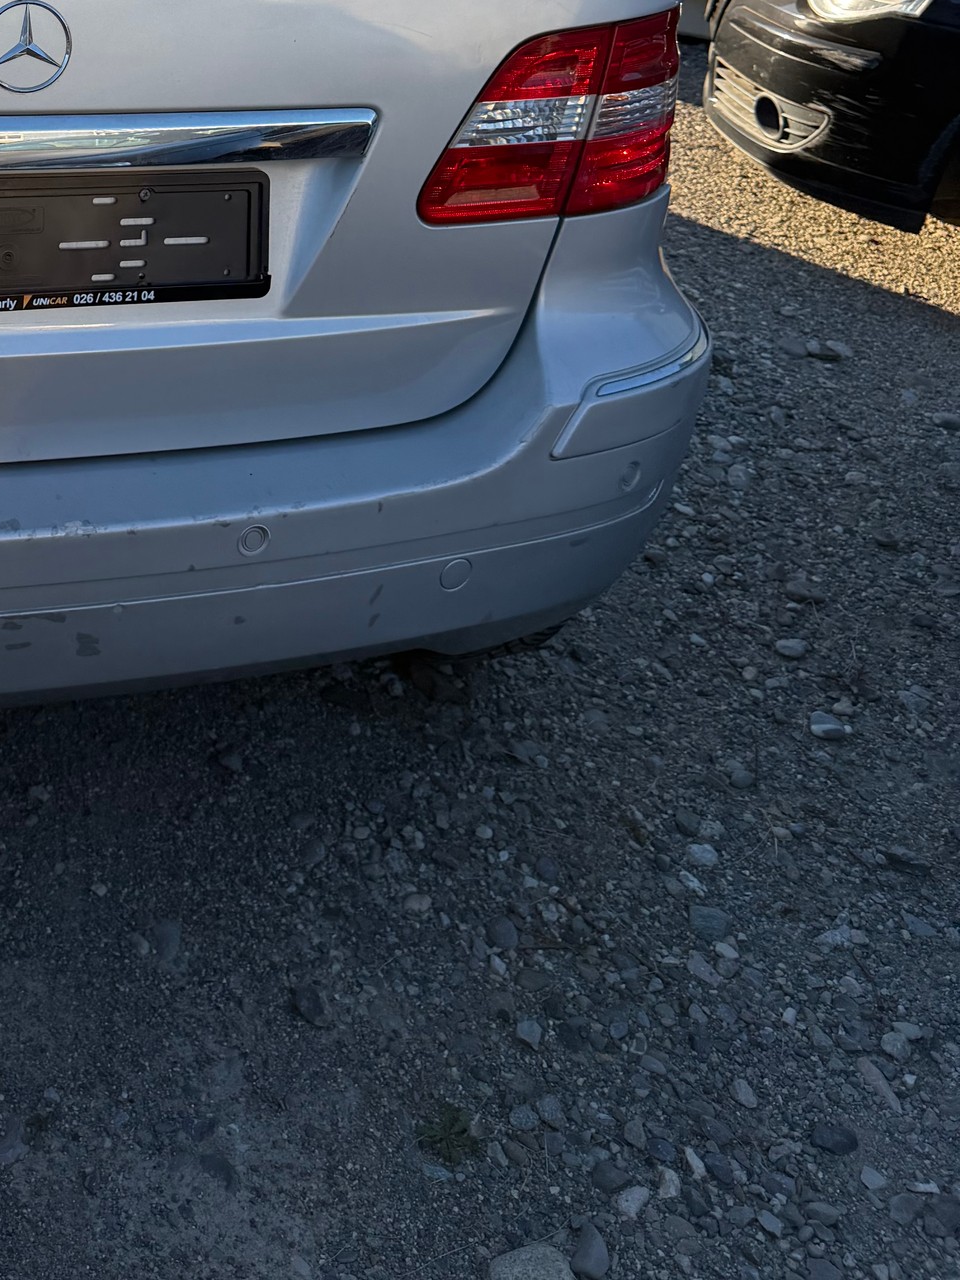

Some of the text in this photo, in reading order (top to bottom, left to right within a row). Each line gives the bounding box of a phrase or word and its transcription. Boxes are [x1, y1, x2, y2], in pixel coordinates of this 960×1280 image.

[73, 293, 94, 304] 026
[95, 292, 100, 304] /
[102, 291, 123, 303] 436
[125, 291, 138, 302] 21
[141, 290, 155, 301] 04
